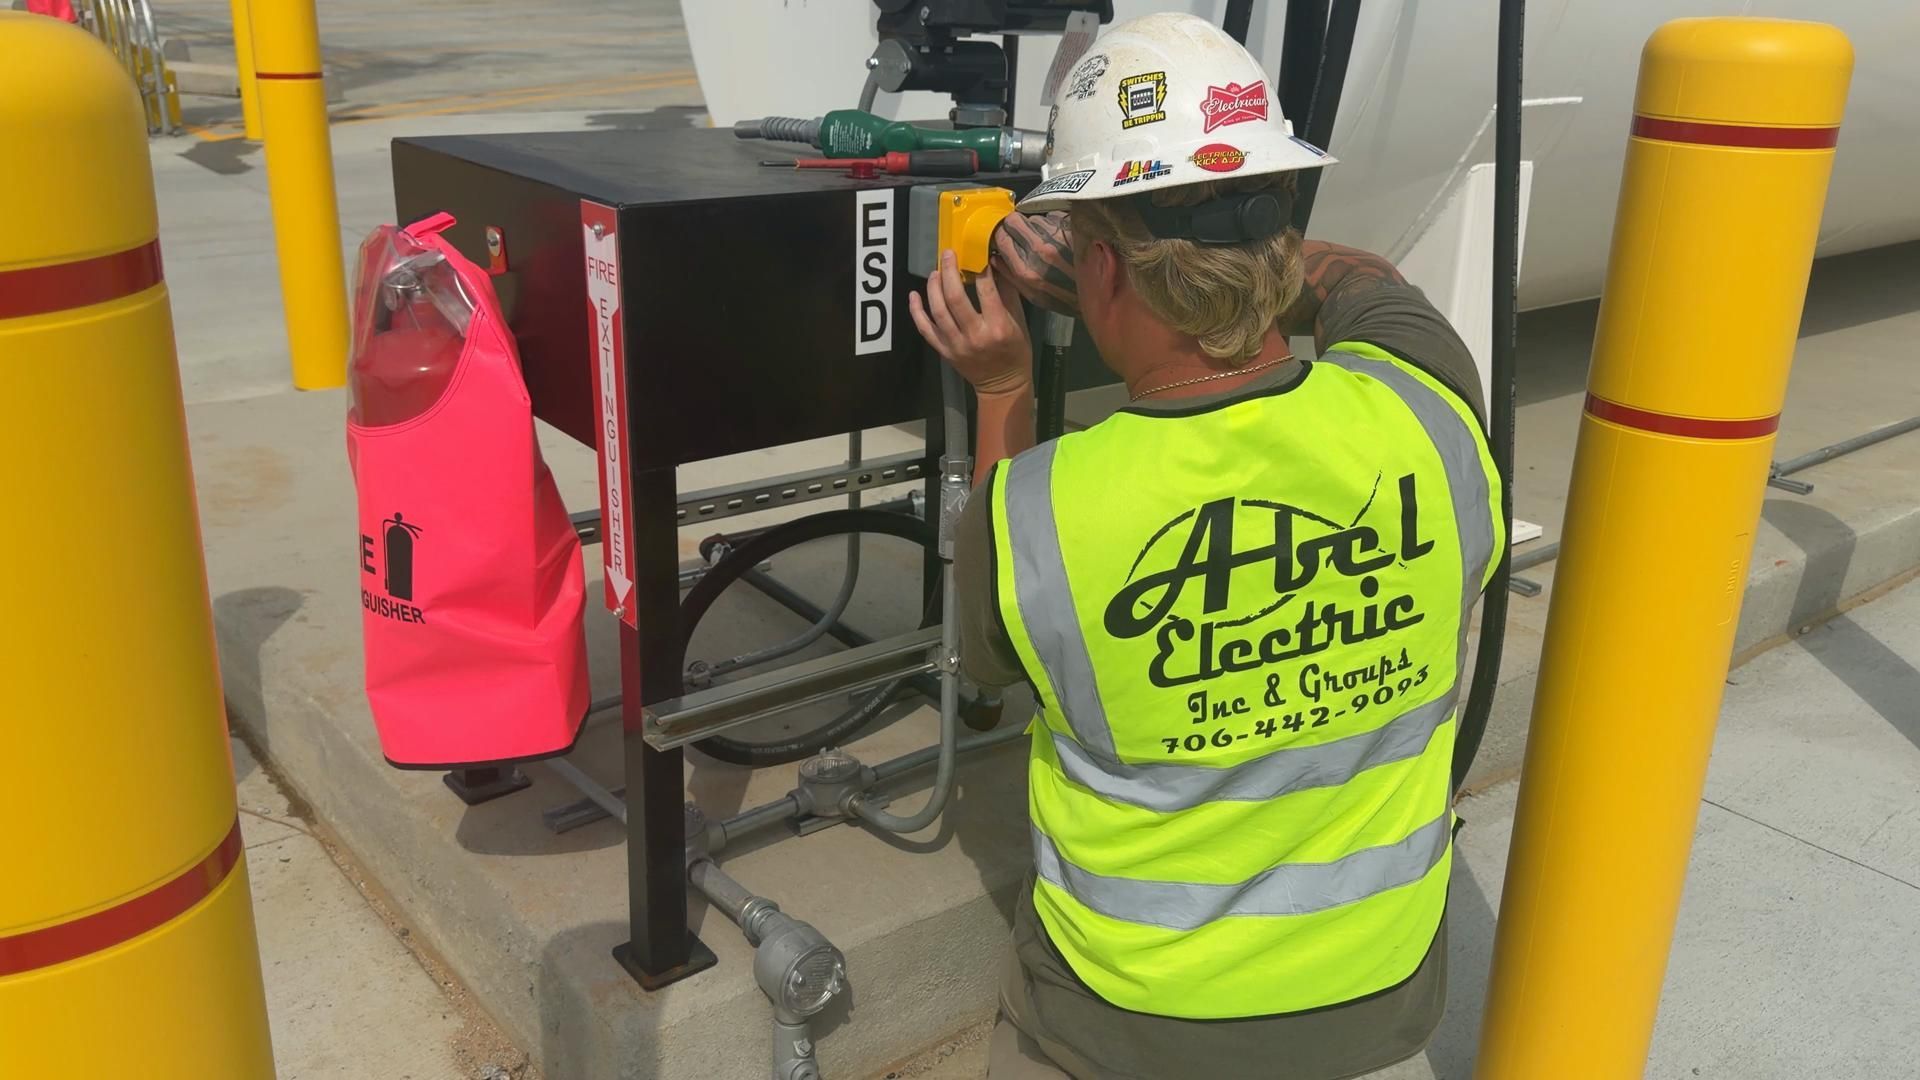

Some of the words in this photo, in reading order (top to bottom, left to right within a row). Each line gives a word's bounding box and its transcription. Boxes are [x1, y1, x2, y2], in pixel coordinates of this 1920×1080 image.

[1122, 73, 1164, 87] SWITCHES
[1202, 95, 1268, 116] Electrician
[1123, 120, 1133, 128] BE
[1134, 112, 1165, 124] TRIPPIN
[1197, 157, 1217, 166] KICK
[588, 257, 616, 285] FIRE
[861, 202, 887, 343] ESD
[600, 298, 623, 575] EXTINGUISHER
[1149, 576, 1425, 688] Electric
[1162, 665, 1428, 753] 706-442-9093
[1188, 690, 1251, 724] Inc
[1263, 673, 1286, 707] &
[1300, 648, 1413, 702] Groups
